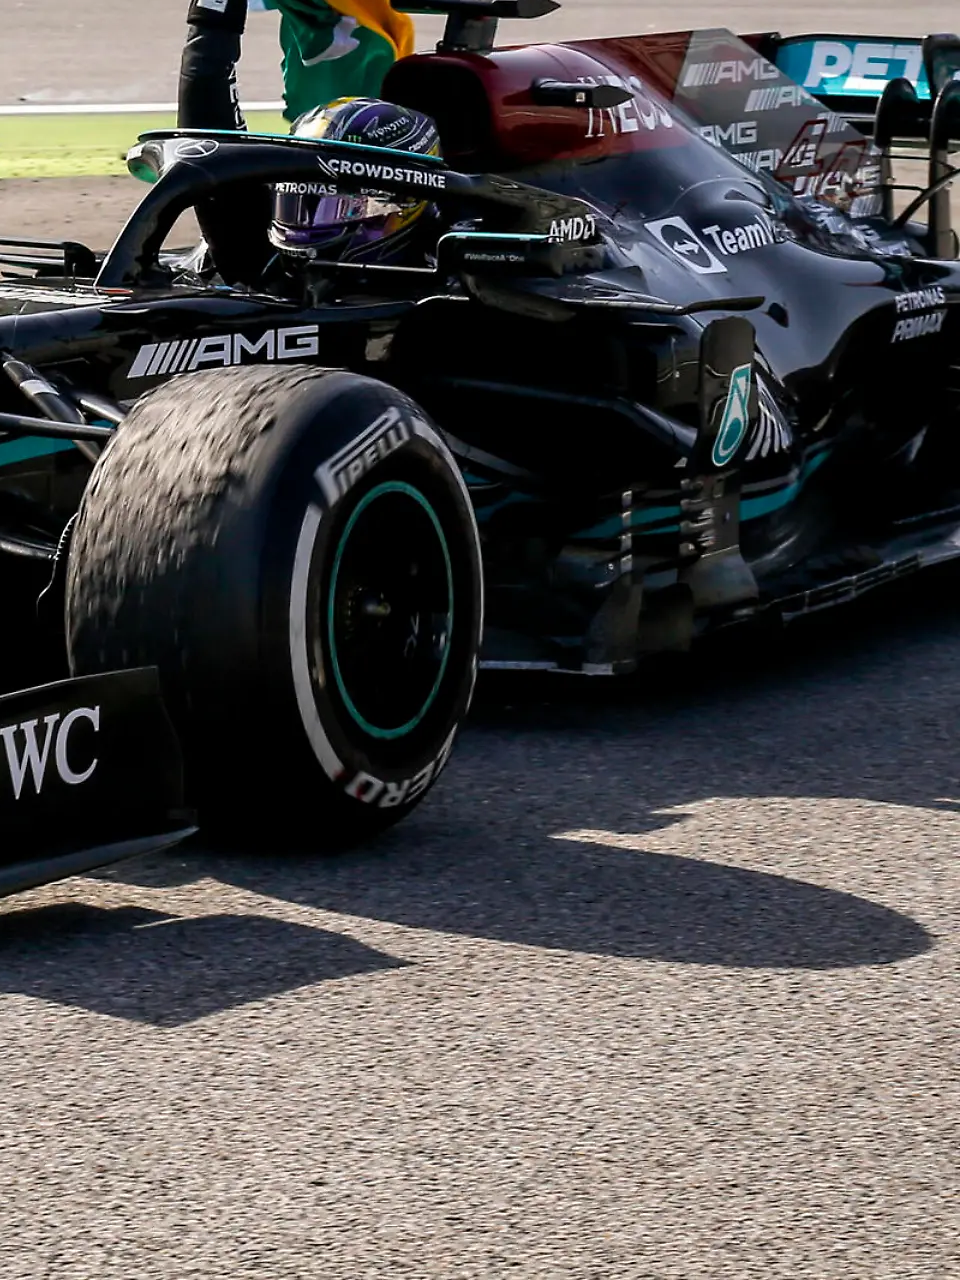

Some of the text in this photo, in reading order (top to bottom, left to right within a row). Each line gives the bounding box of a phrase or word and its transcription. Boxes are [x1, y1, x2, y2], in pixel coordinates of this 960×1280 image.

[716, 58, 780, 84] AMG
[326, 158, 446, 189] CROWDSTRIKE
[547, 218, 586, 244] AMD
[192, 324, 319, 367] AMG
[315, 407, 414, 507] PIRELLI
